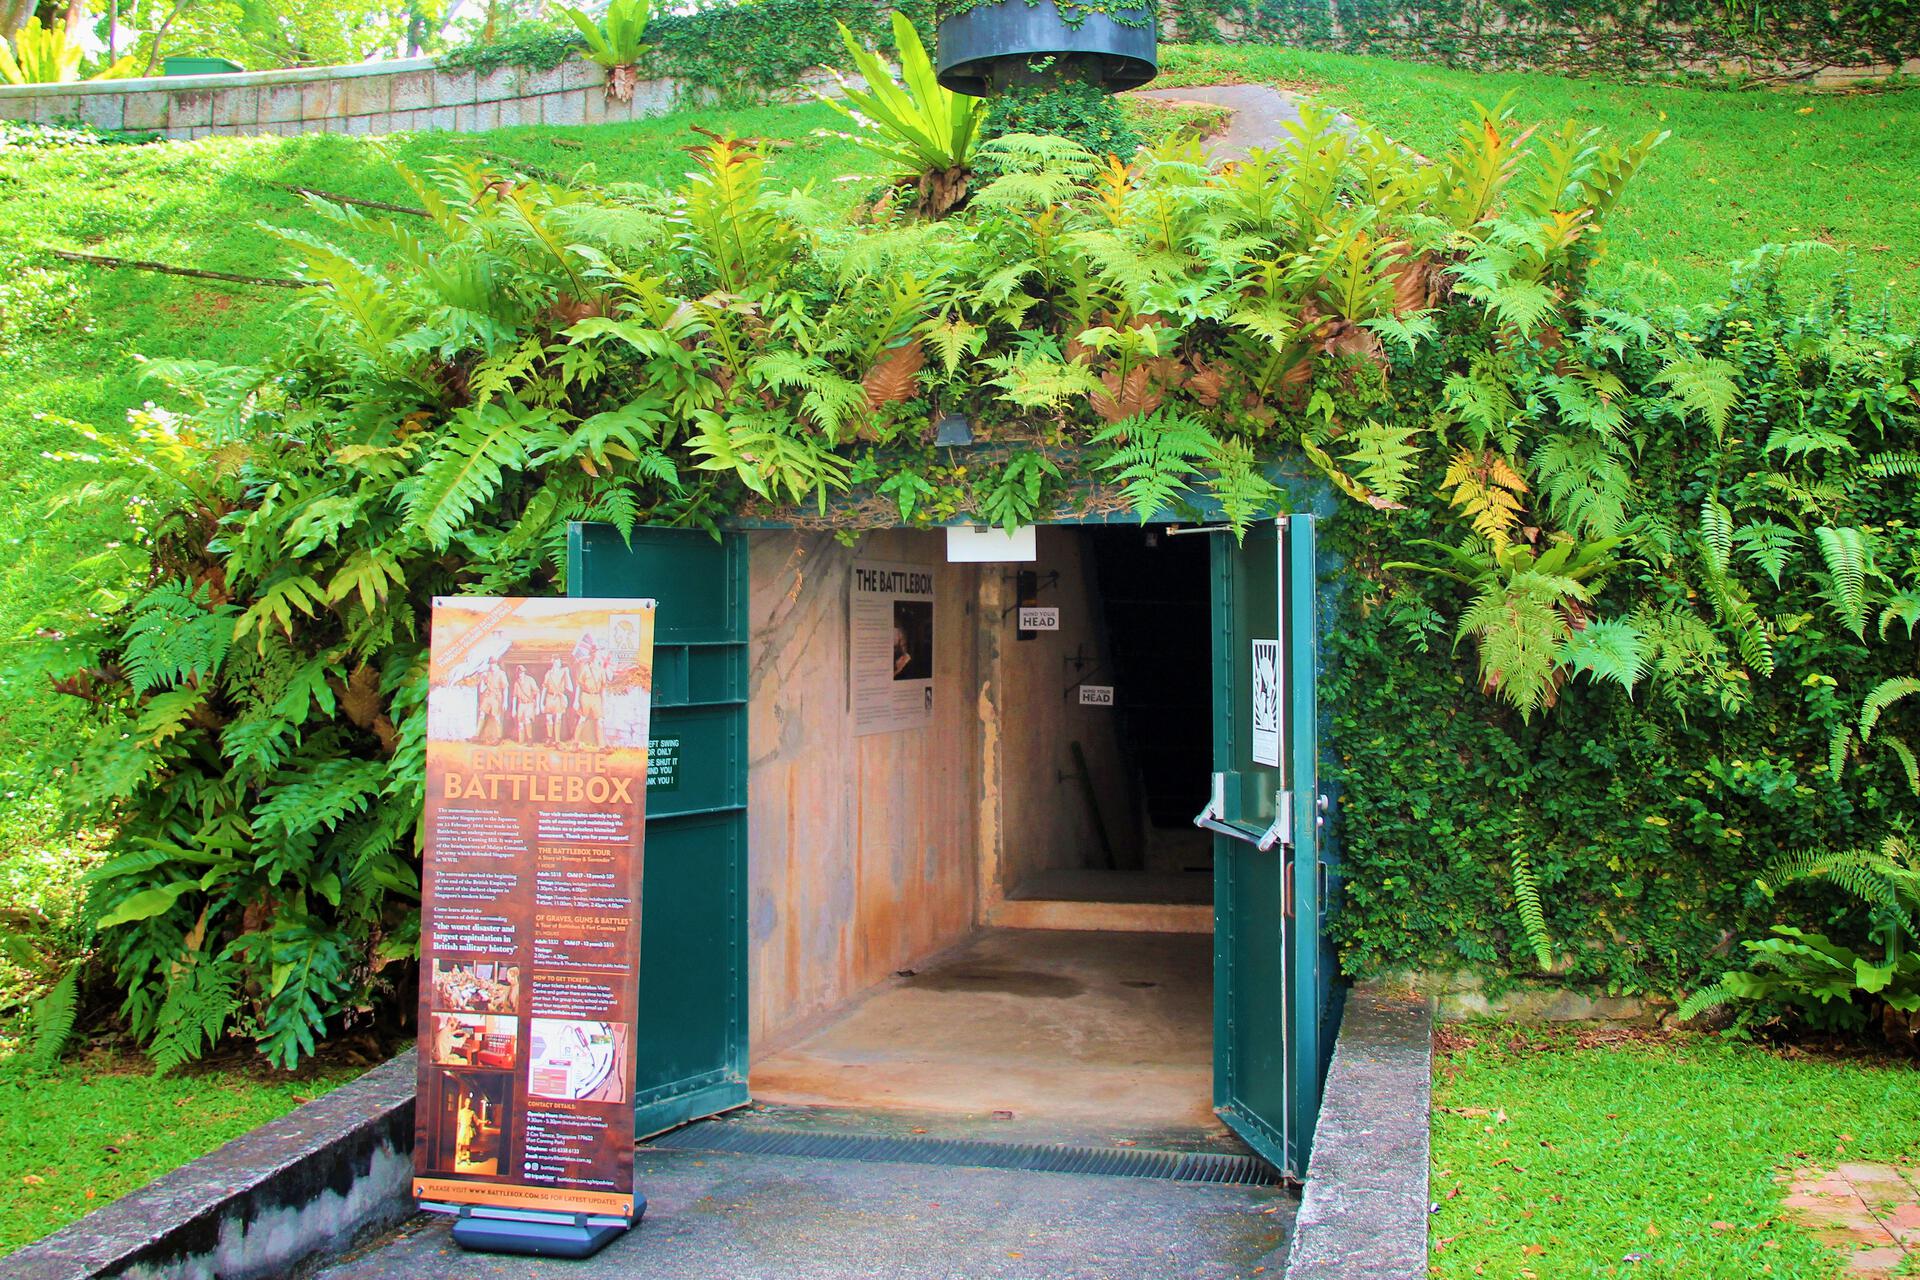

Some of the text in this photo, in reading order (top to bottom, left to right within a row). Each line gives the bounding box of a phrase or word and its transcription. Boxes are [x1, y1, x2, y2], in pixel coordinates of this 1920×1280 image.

[856, 569, 933, 594] THE BATTLEBOX
[1024, 617, 1055, 626] HEAD
[1082, 694, 1110, 702] HEAD
[656, 748, 672, 756] ONLY
[472, 751, 607, 773] ENTER THE
[656, 758, 671, 766] SHUT
[660, 766, 672, 774] YOU
[444, 772, 633, 804] BATTLEBOX
[450, 922, 470, 930] worst
[472, 923, 500, 932] disaster
[501, 924, 514, 933] and
[433, 931, 510, 944] largest capitulation in
[433, 941, 458, 950] British
[459, 942, 487, 953] military
[527, 1100, 552, 1108] CONTACT
[588, 1197, 617, 1205] UPDATES
